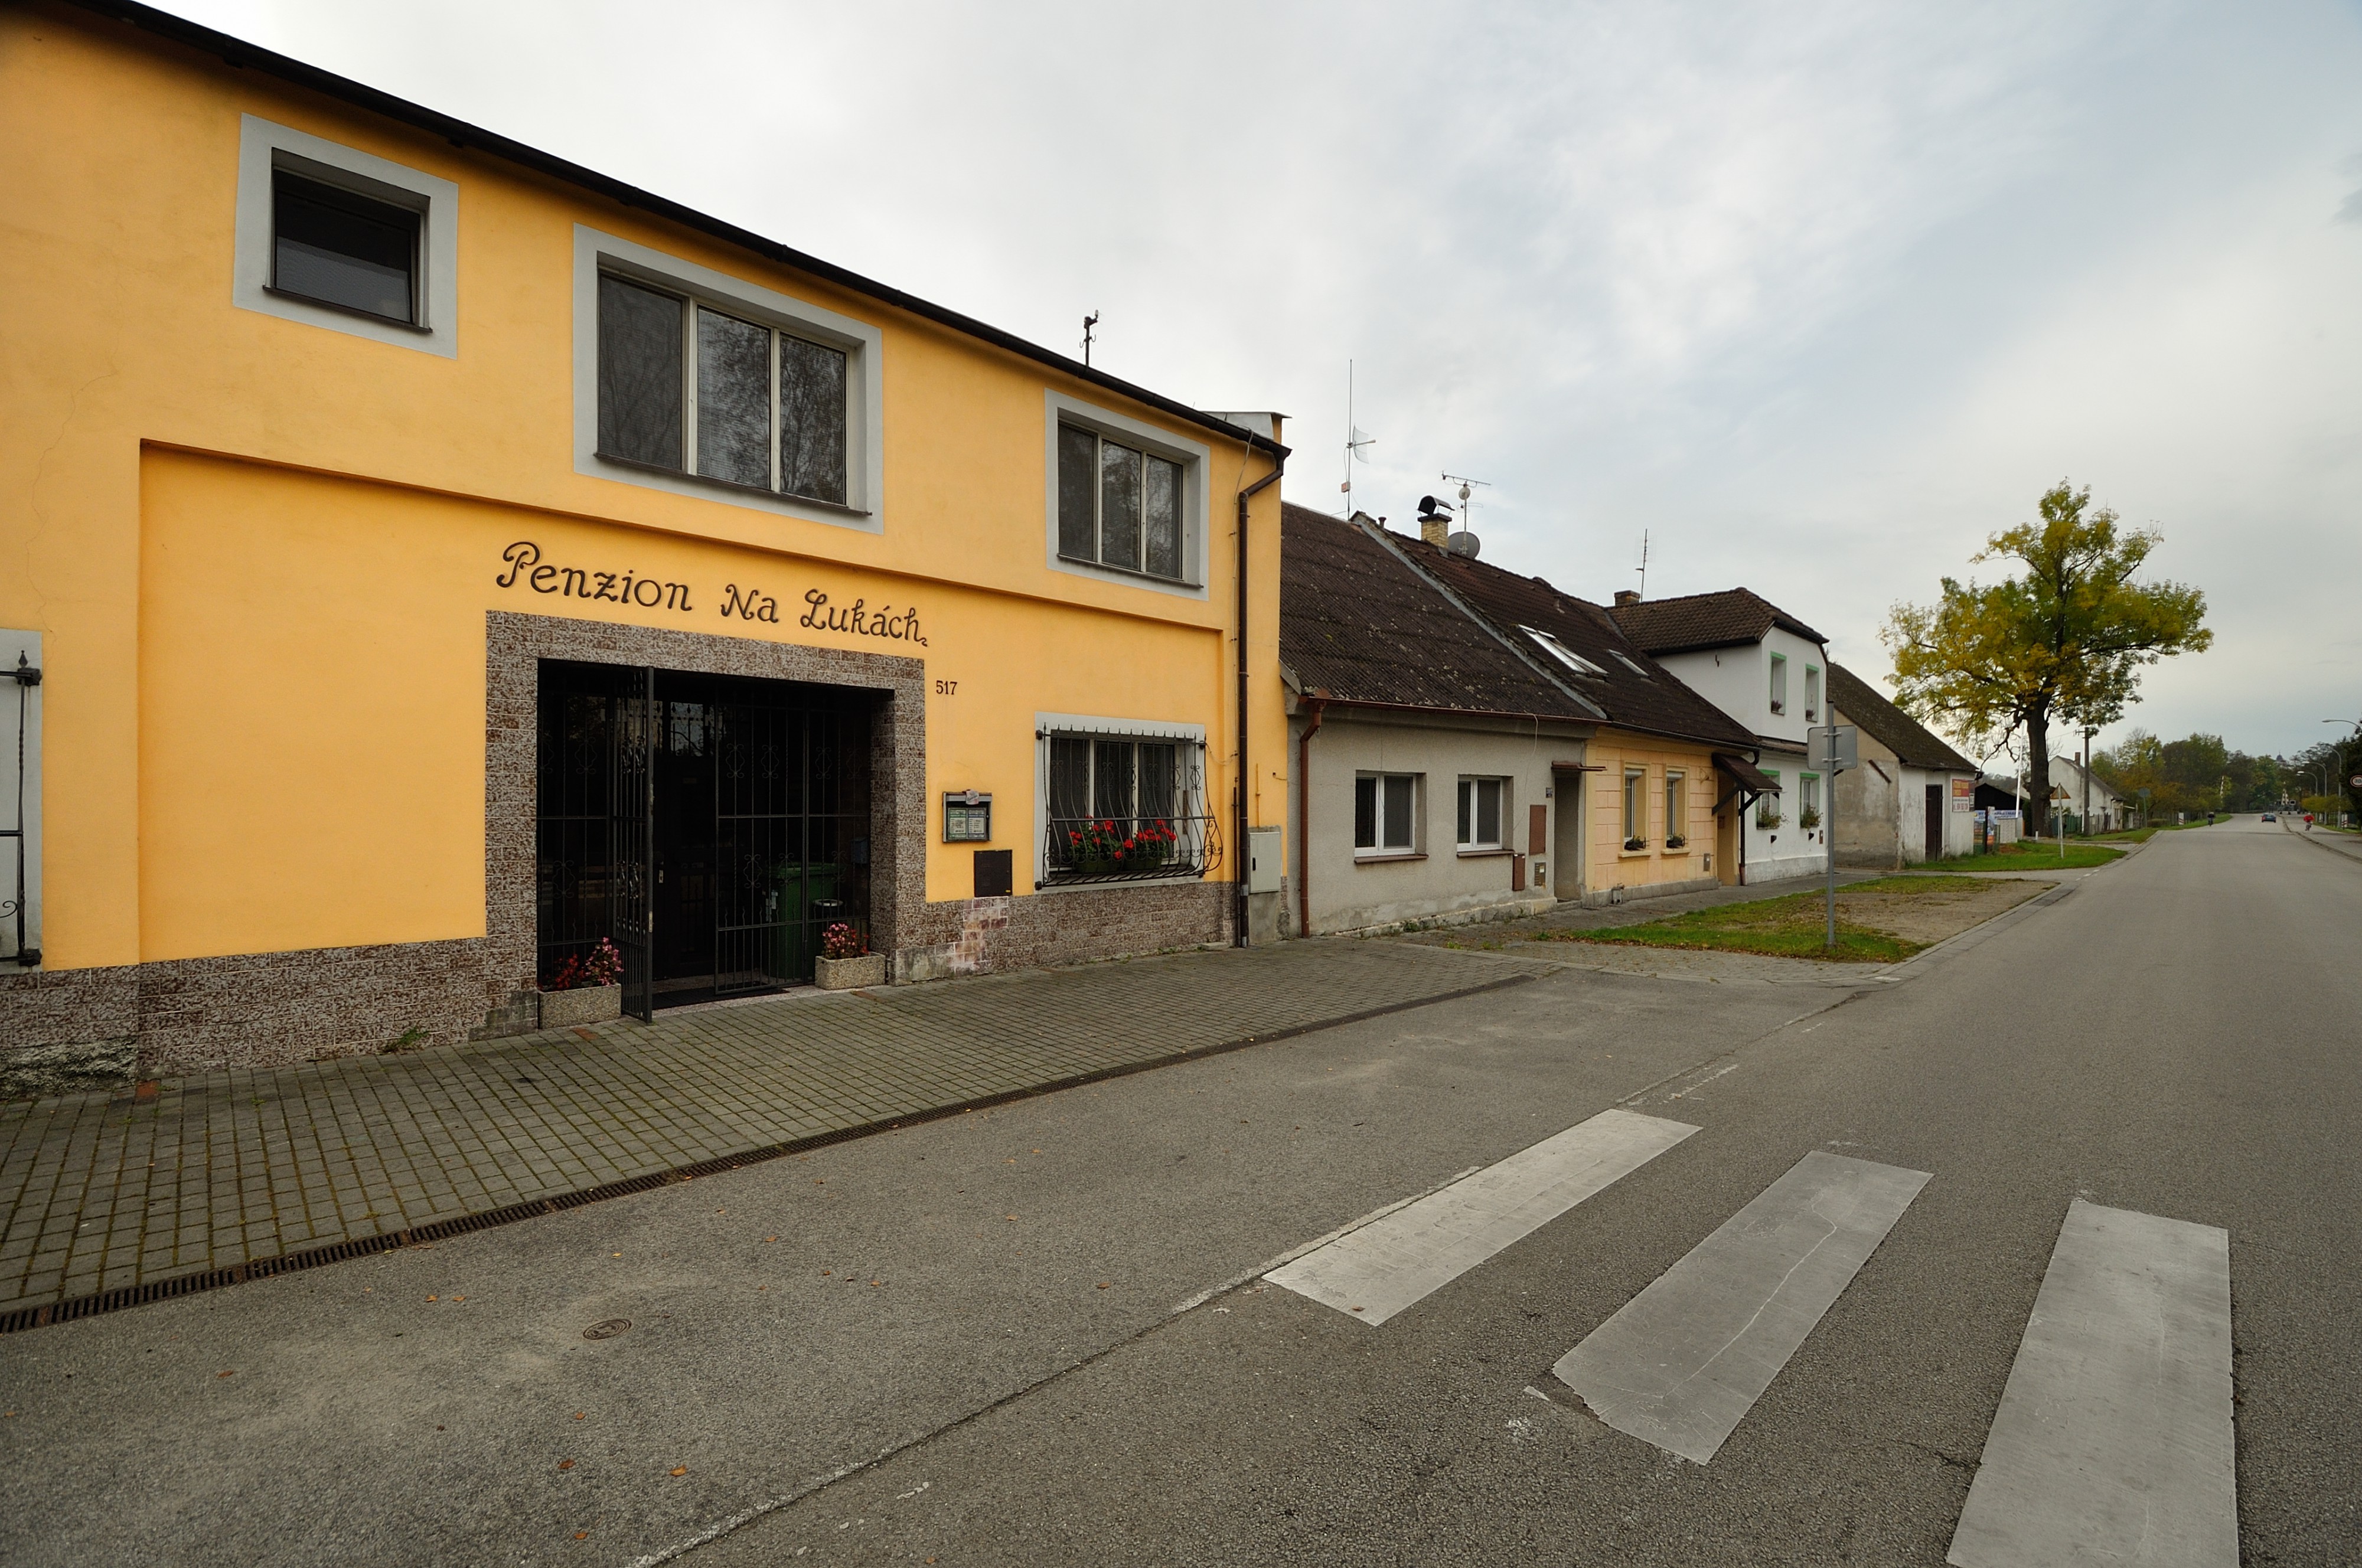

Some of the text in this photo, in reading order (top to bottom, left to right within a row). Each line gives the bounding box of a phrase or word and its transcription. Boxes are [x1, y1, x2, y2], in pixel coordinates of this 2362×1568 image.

[495, 541, 928, 647] Penzion Na Lukách
[936, 680, 958, 695] 517
